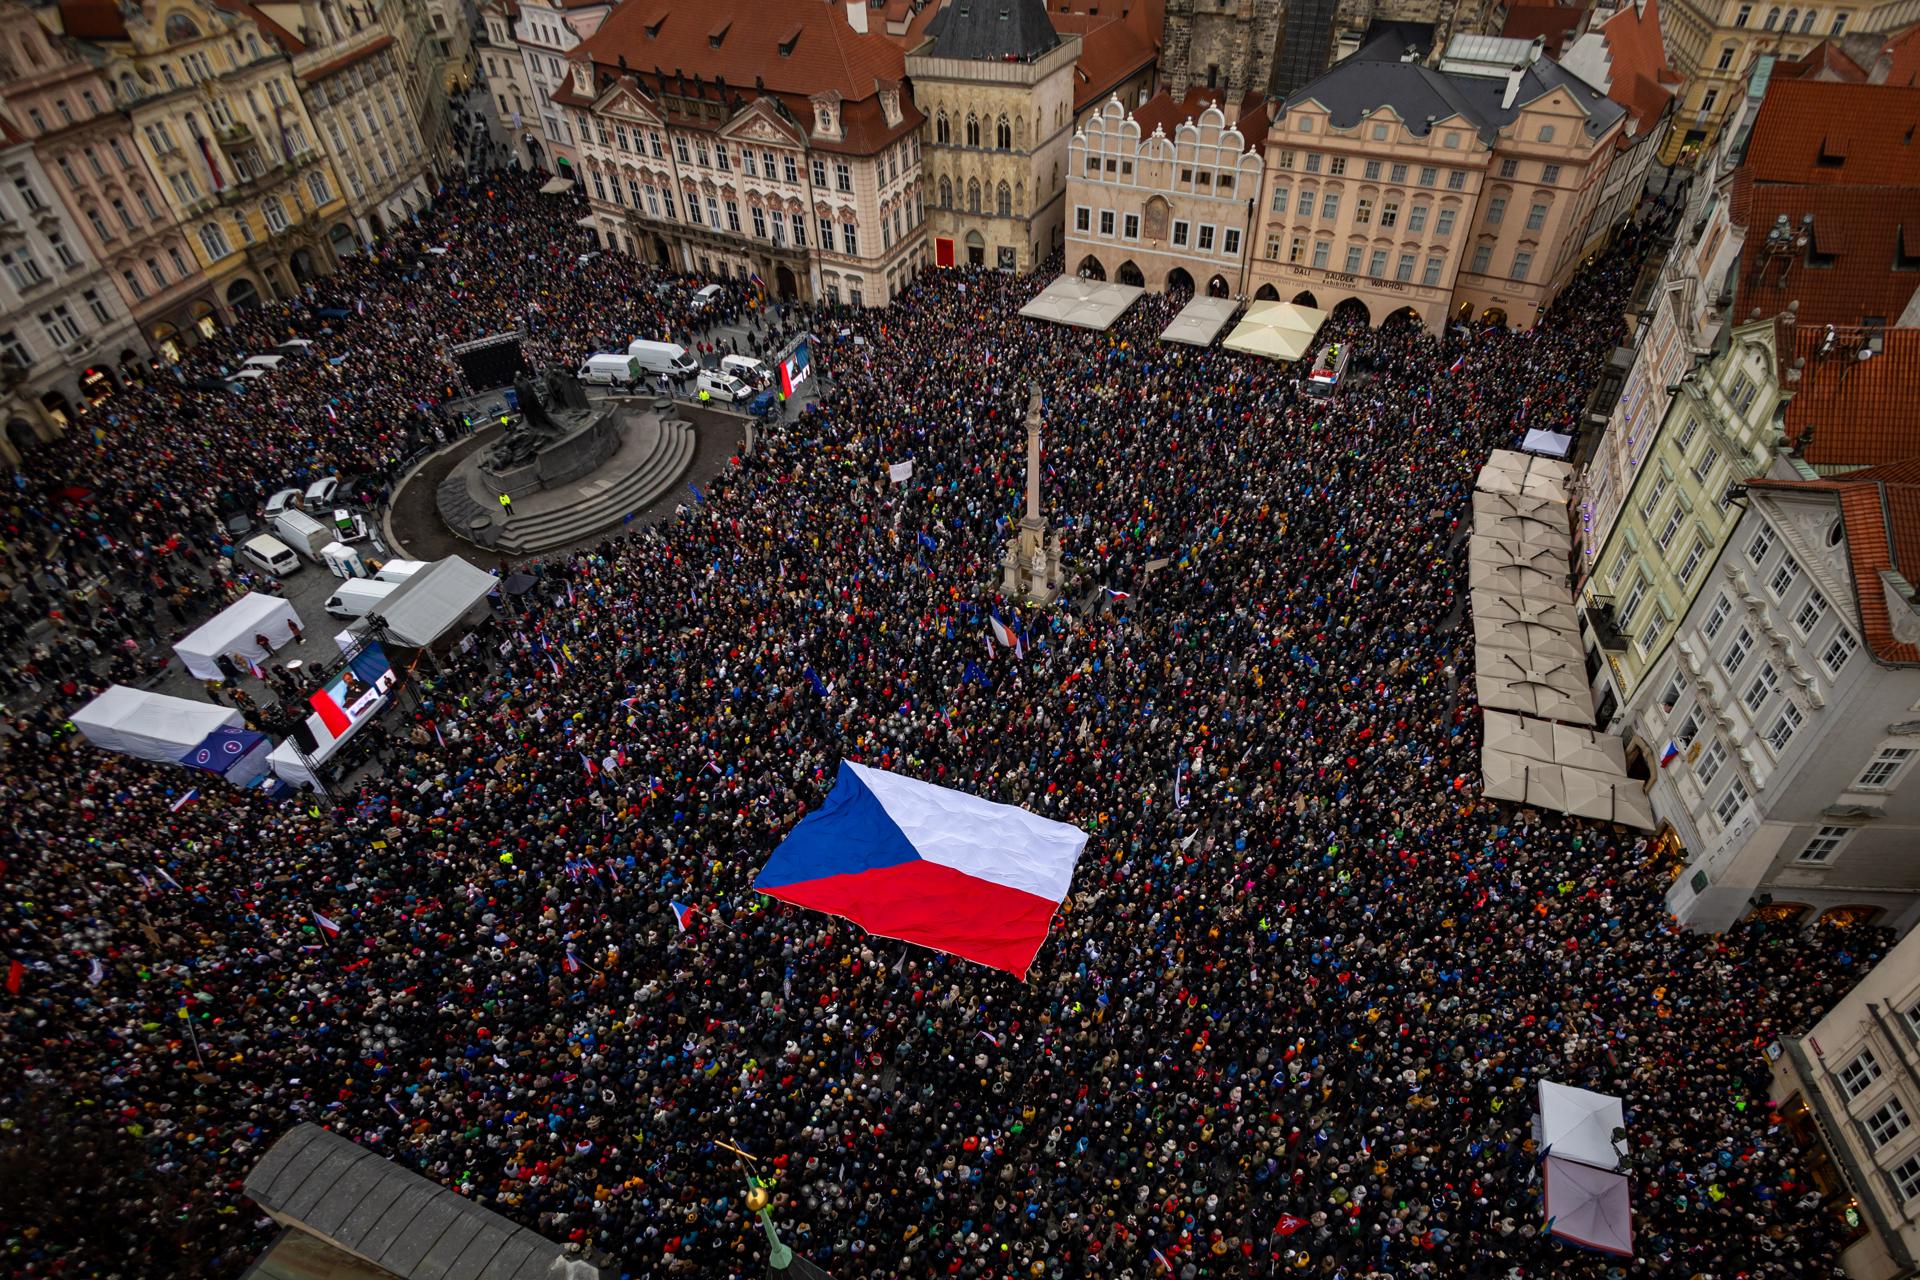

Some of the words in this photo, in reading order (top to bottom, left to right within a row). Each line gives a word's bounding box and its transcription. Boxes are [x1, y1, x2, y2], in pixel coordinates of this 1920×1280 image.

[1324, 272, 1355, 283] SAUDEK
[1371, 279, 1405, 292] WARHOL
[1708, 817, 1751, 864] HOTEL
